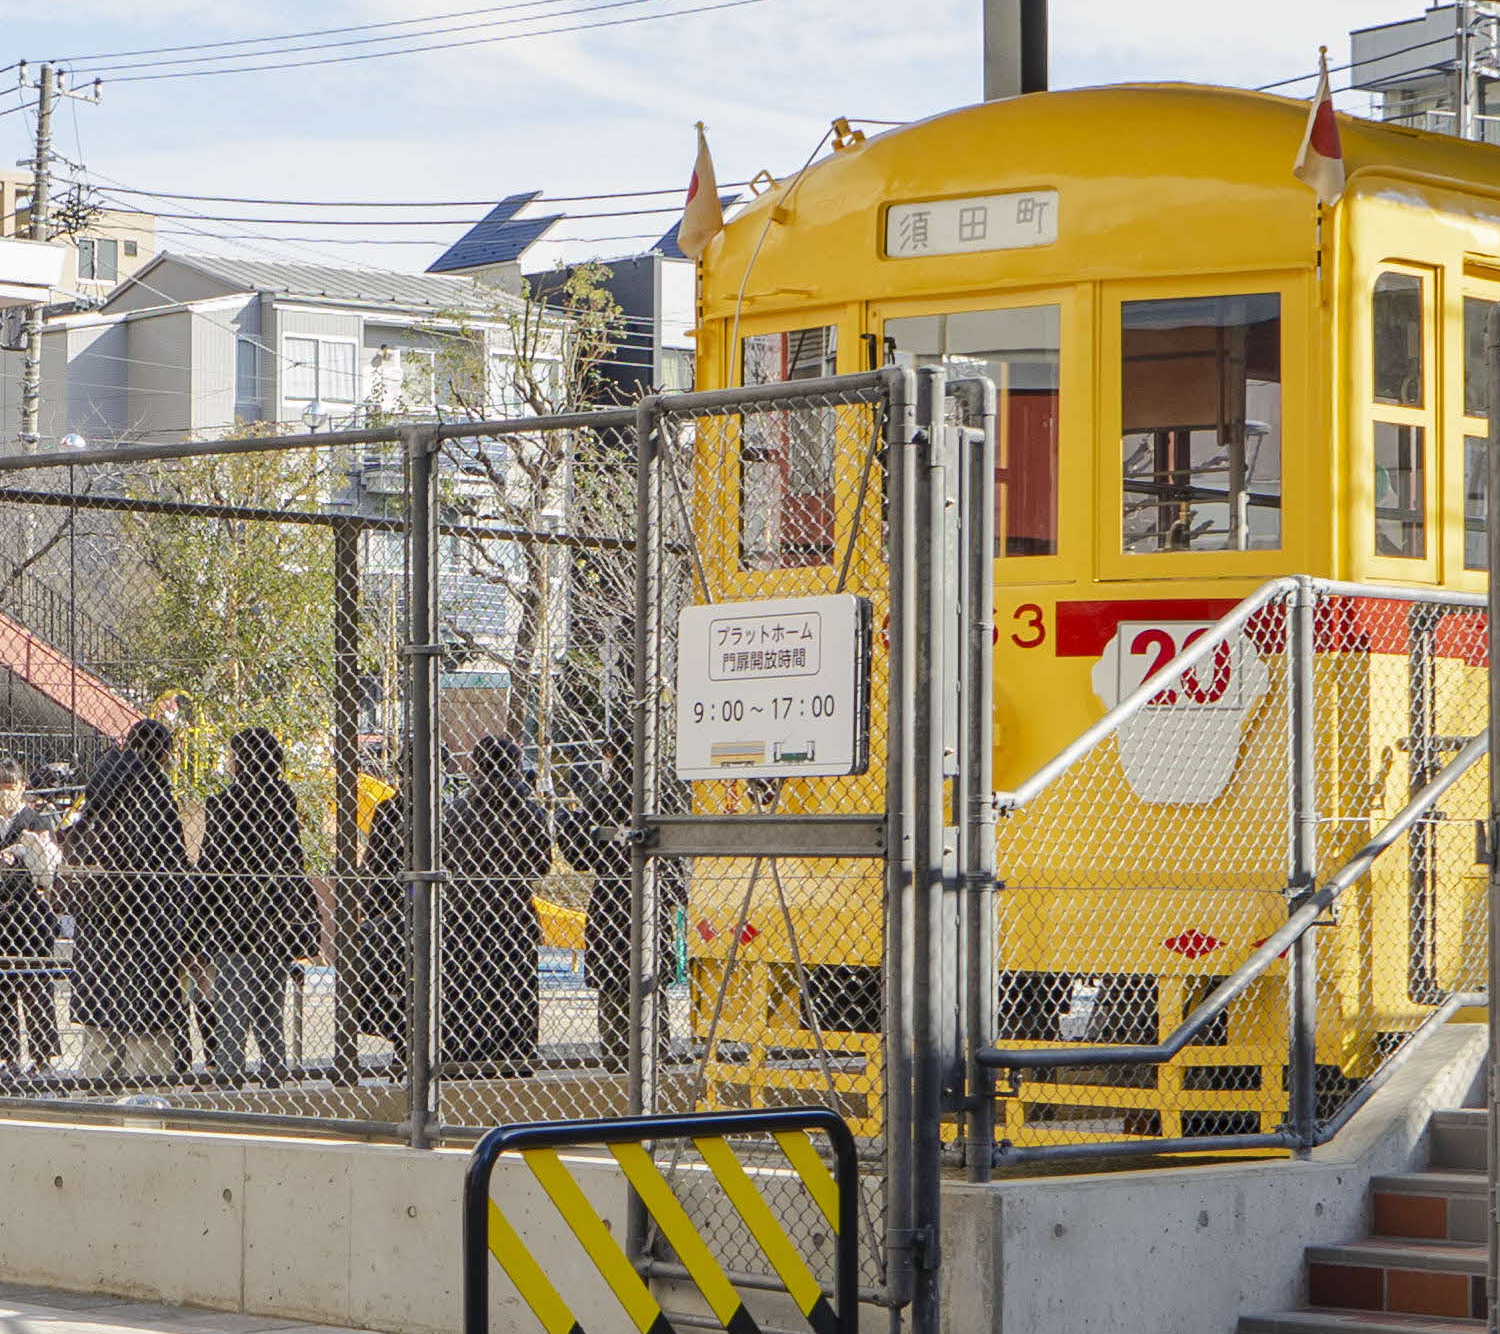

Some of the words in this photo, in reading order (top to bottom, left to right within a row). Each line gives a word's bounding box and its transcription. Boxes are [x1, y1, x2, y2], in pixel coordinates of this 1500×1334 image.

[899, 197, 1051, 251] 須田町
[717, 621, 814, 647] プラットホーム
[722, 647, 807, 674] 門扉開放時間
[1130, 628, 1232, 705] 20
